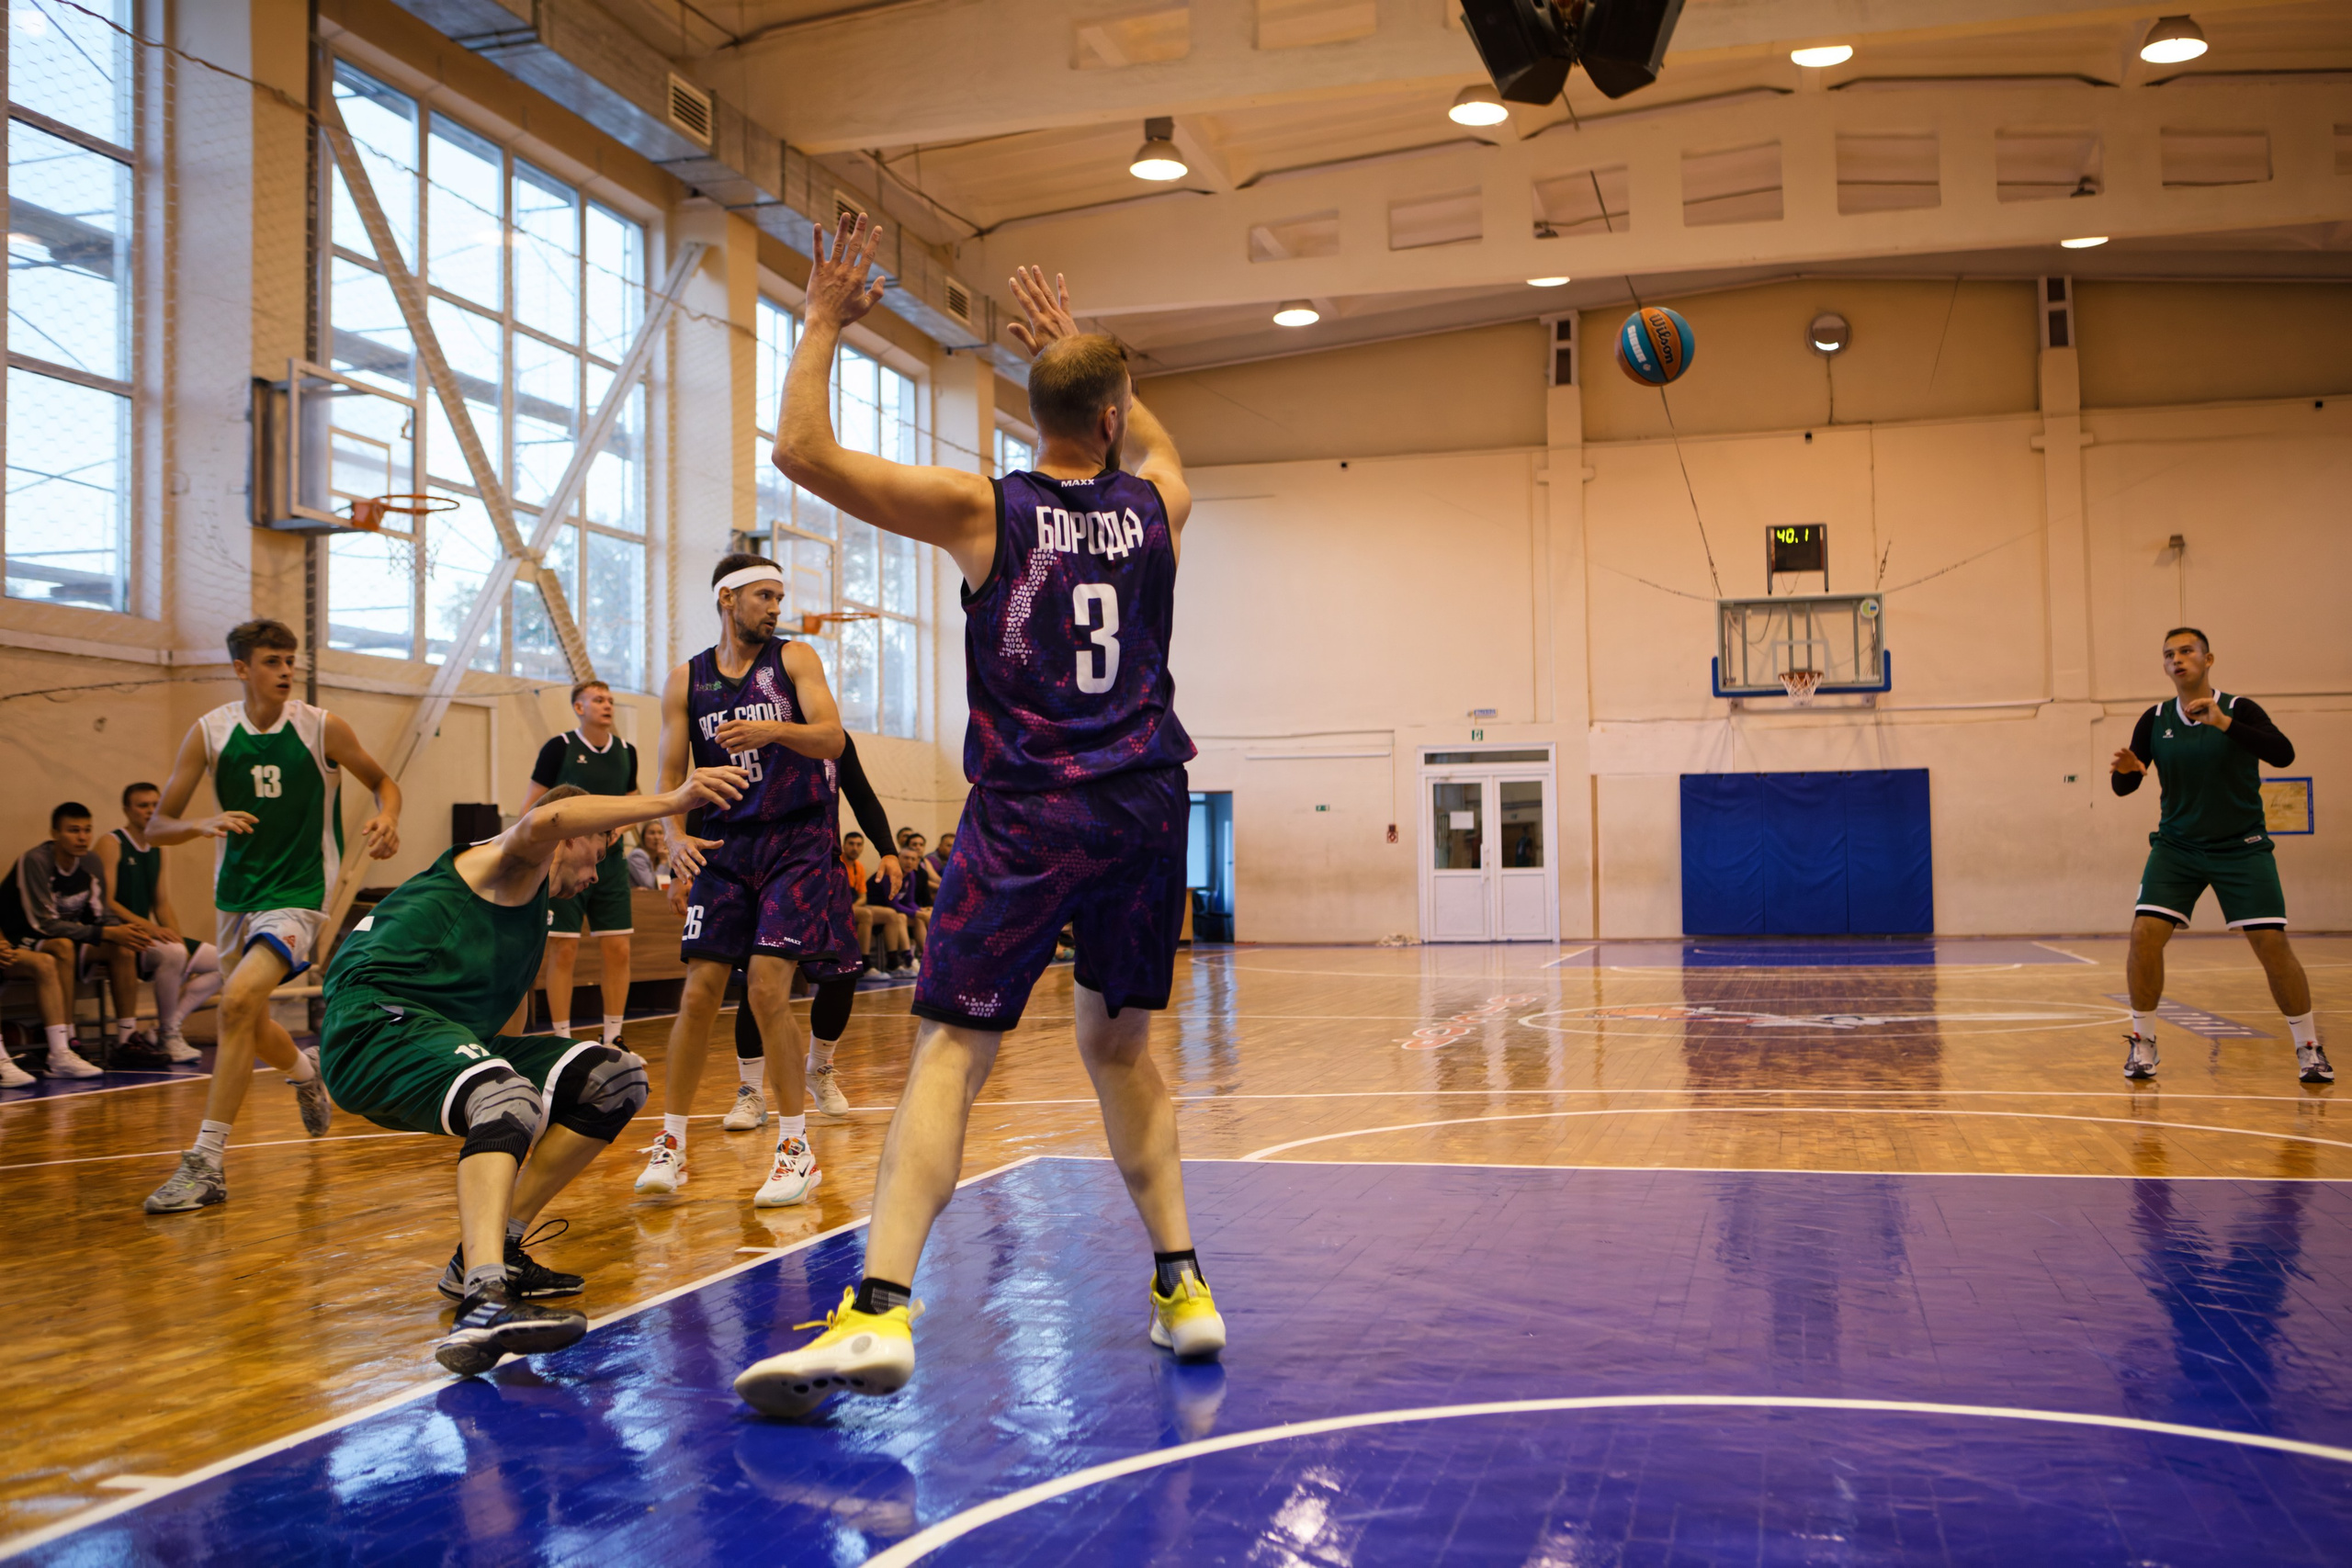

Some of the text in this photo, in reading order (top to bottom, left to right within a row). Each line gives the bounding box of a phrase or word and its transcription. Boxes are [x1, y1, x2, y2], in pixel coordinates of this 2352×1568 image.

[1648, 313, 1674, 365] Wilson
[1061, 479, 1095, 488] MAXX
[1035, 505, 1144, 561] БОРОДА
[1072, 583, 1120, 694] 3
[250, 764, 283, 798] 13
